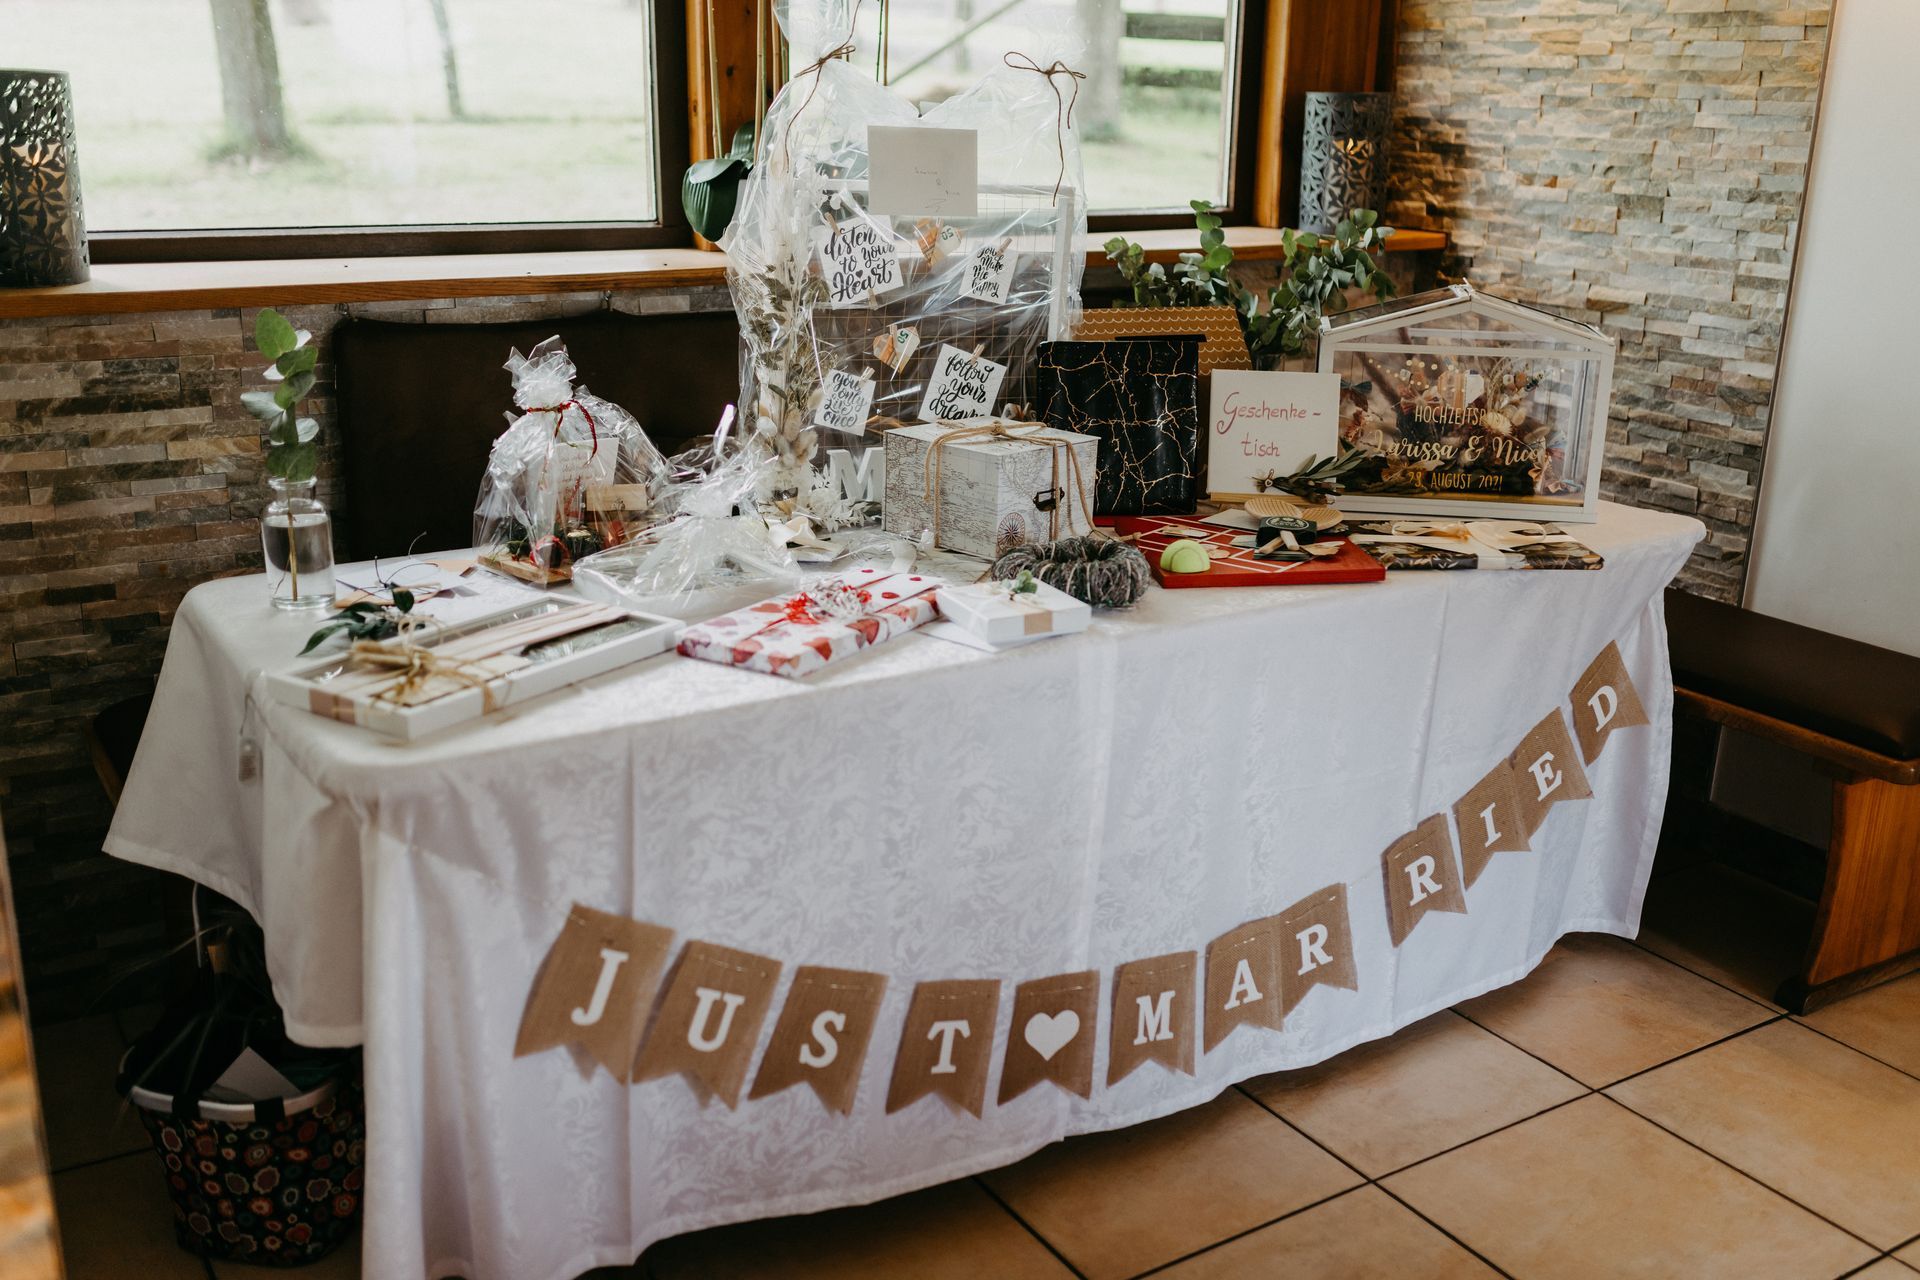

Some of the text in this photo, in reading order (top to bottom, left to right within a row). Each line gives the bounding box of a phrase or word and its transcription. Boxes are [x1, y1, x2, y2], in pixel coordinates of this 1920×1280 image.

[941, 228, 954, 240] 50
[839, 236, 895, 275] to your
[831, 258, 895, 302] Heart
[896, 330, 909, 344] 50
[929, 384, 985, 420] dream
[945, 378, 986, 403] your
[1241, 432, 1280, 457] tisch
[1371, 429, 1458, 462] Larissa
[1431, 473, 1472, 490] AUGUST
[571, 684, 1618, 1075] JUST MARRIED
